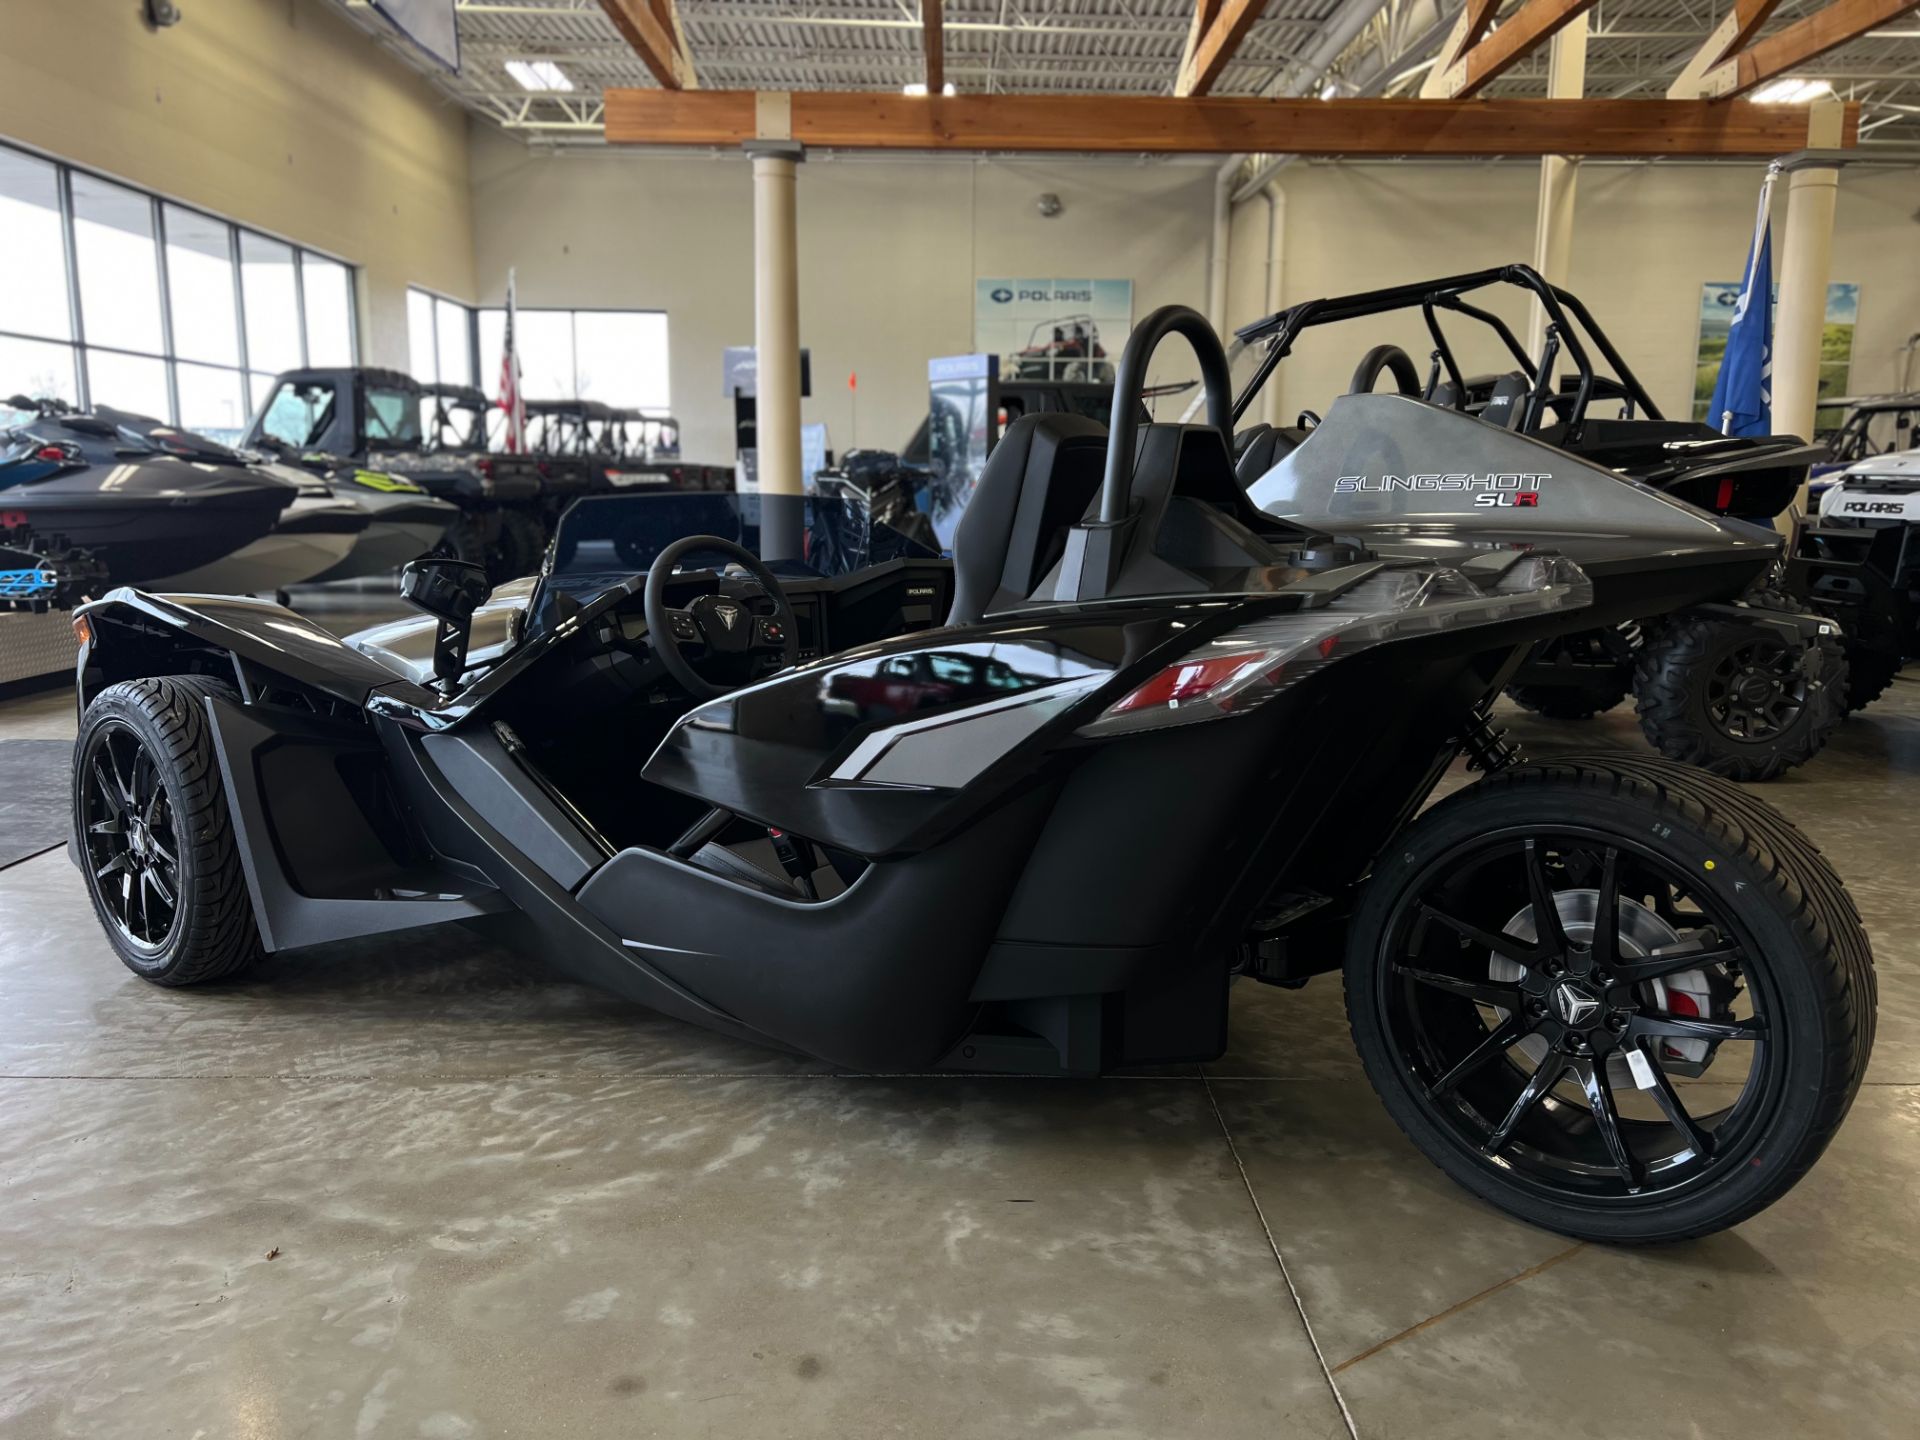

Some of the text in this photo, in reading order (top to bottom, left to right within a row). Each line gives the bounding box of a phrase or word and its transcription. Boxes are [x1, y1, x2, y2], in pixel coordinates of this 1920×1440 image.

[1018, 290, 1092, 302] POLARIS
[1334, 473, 1553, 493] SLINGSHOT
[1474, 492, 1538, 507] SLR
[1844, 502, 1905, 514] POLARIS
